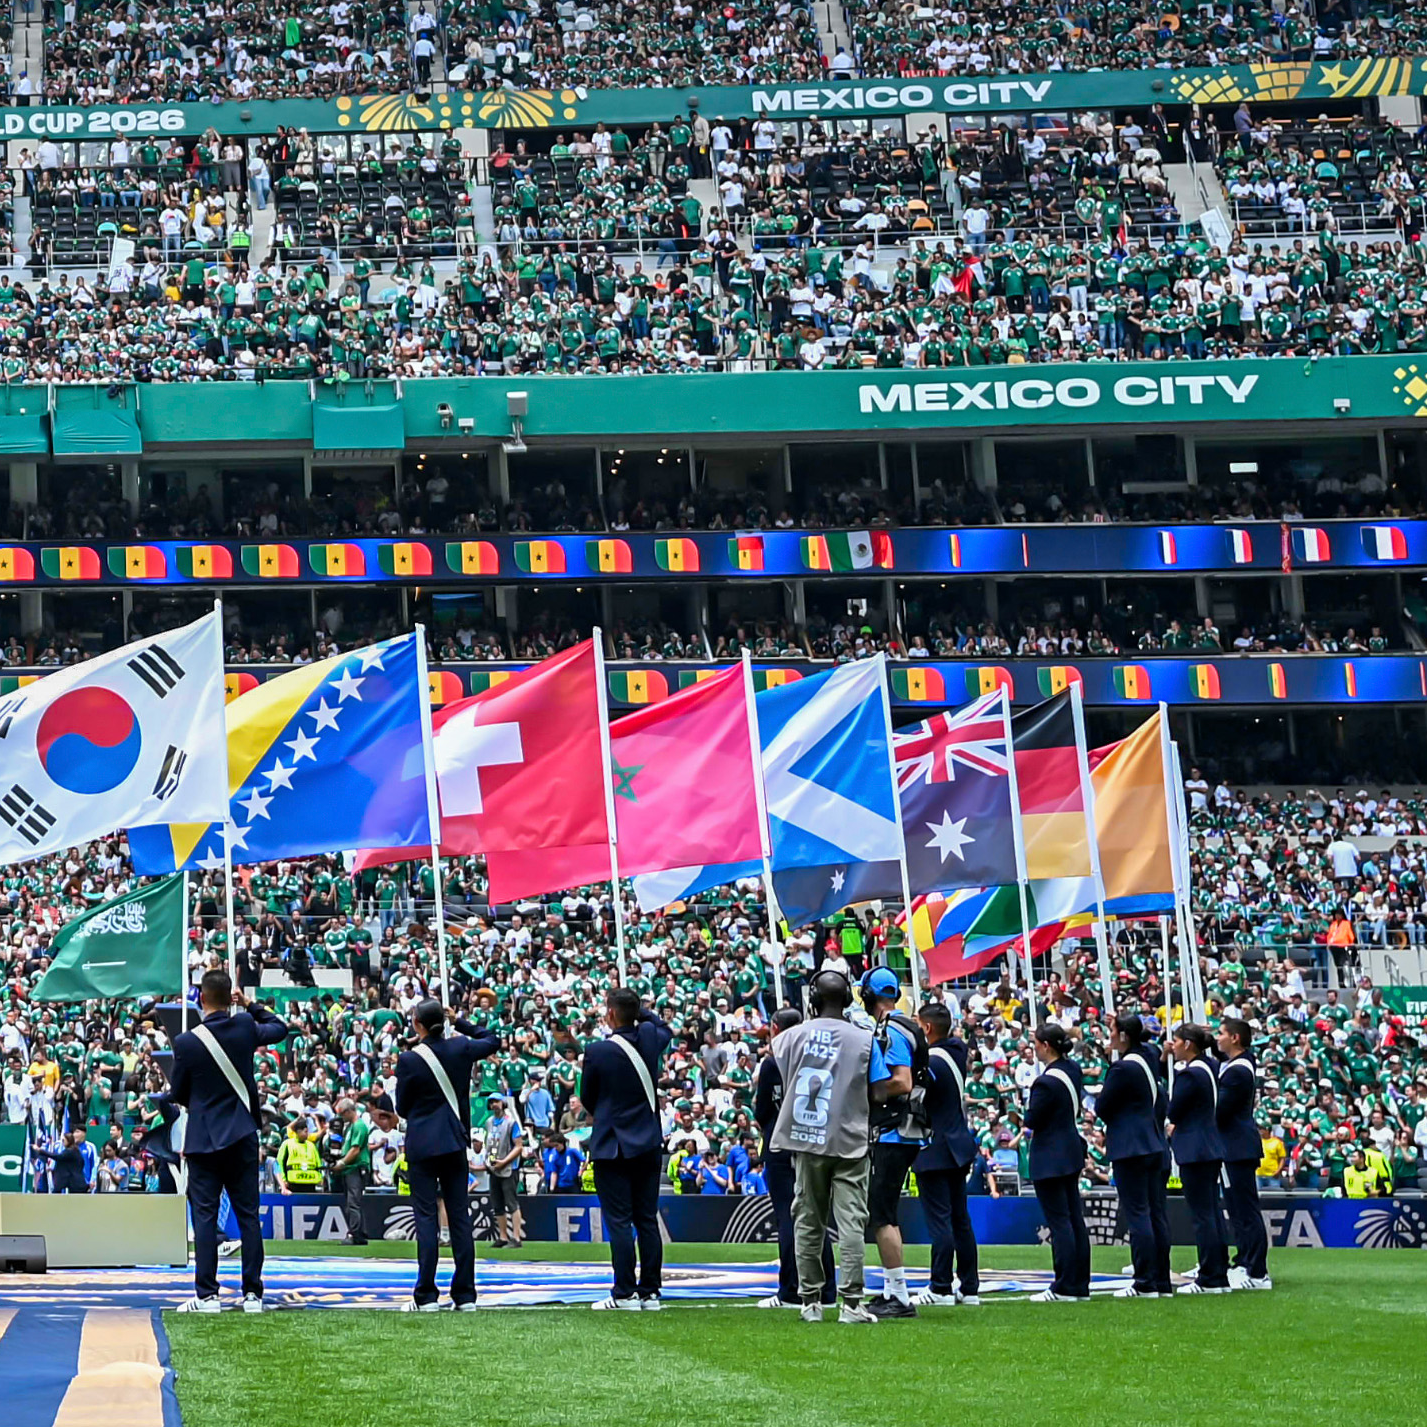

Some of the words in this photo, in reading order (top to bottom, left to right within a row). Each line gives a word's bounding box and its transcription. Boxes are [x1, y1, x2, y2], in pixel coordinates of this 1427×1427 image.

[752, 84, 933, 112] MEXICO
[943, 80, 1052, 107] CITY
[28, 112, 84, 134] CUP
[87, 109, 185, 132] 2026
[858, 378, 1100, 413] MEXICO
[1113, 374, 1259, 406] CITY
[809, 1029, 832, 1044] HB
[803, 1041, 837, 1061] 0425
[803, 1112, 818, 1121] FIFA
[790, 1130, 826, 1145] 2026
[1260, 1209, 1326, 1248] FA
